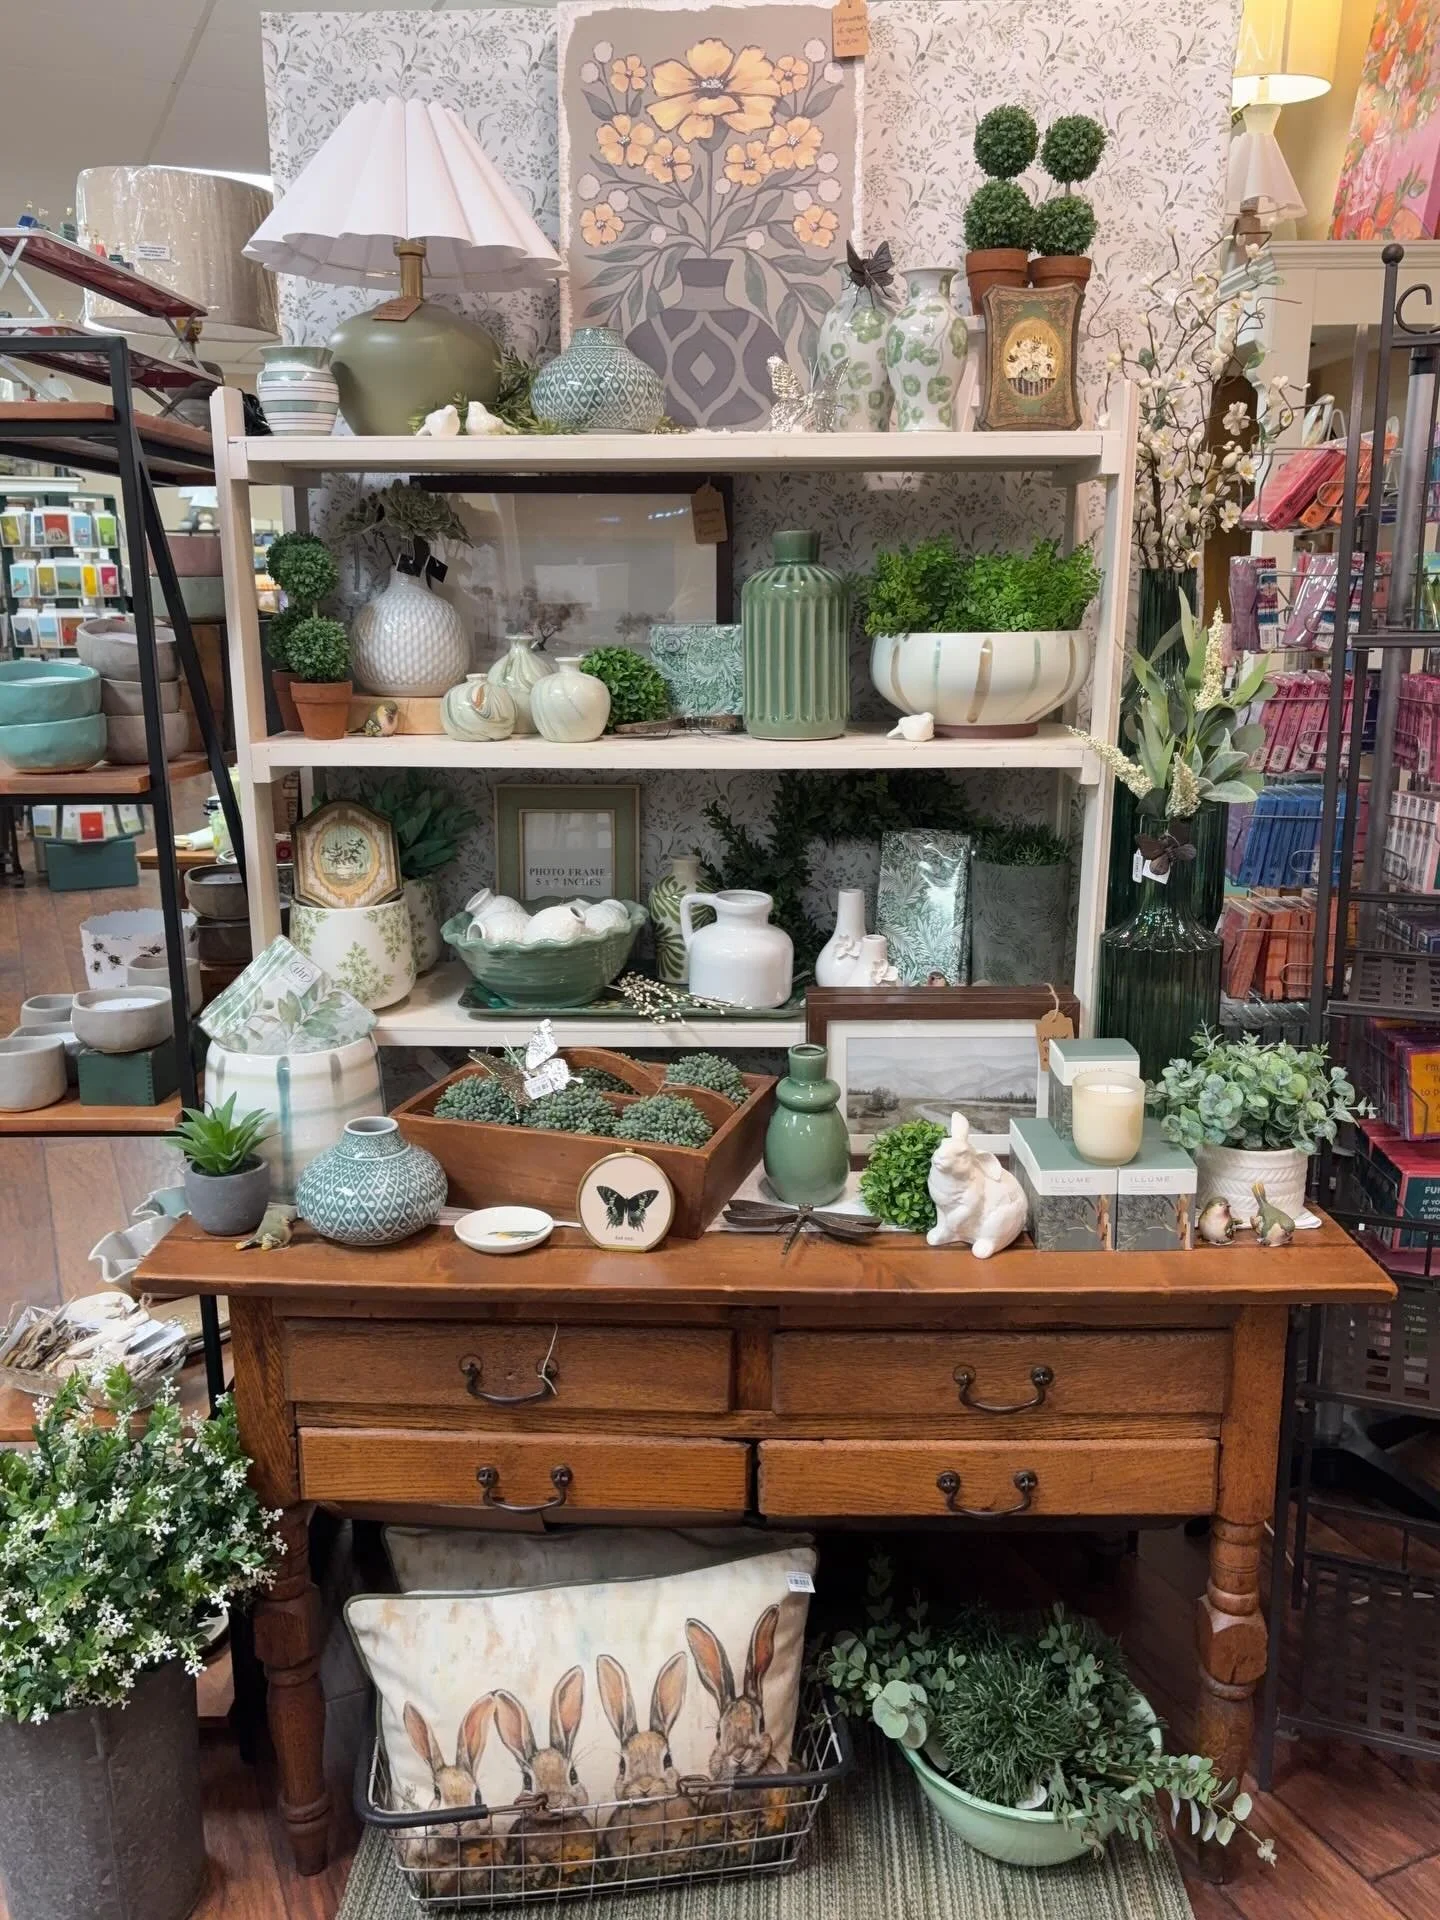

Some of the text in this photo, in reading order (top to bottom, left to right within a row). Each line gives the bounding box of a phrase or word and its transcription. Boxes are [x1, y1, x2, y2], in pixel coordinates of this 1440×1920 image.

[529, 867, 606, 877] PHOTO FRAME
[535, 878, 541, 886] 5
[563, 878, 601, 887] INCHES
[1050, 1176, 1092, 1184] ILLUME
[1129, 1175, 1172, 1184] ILLUME
